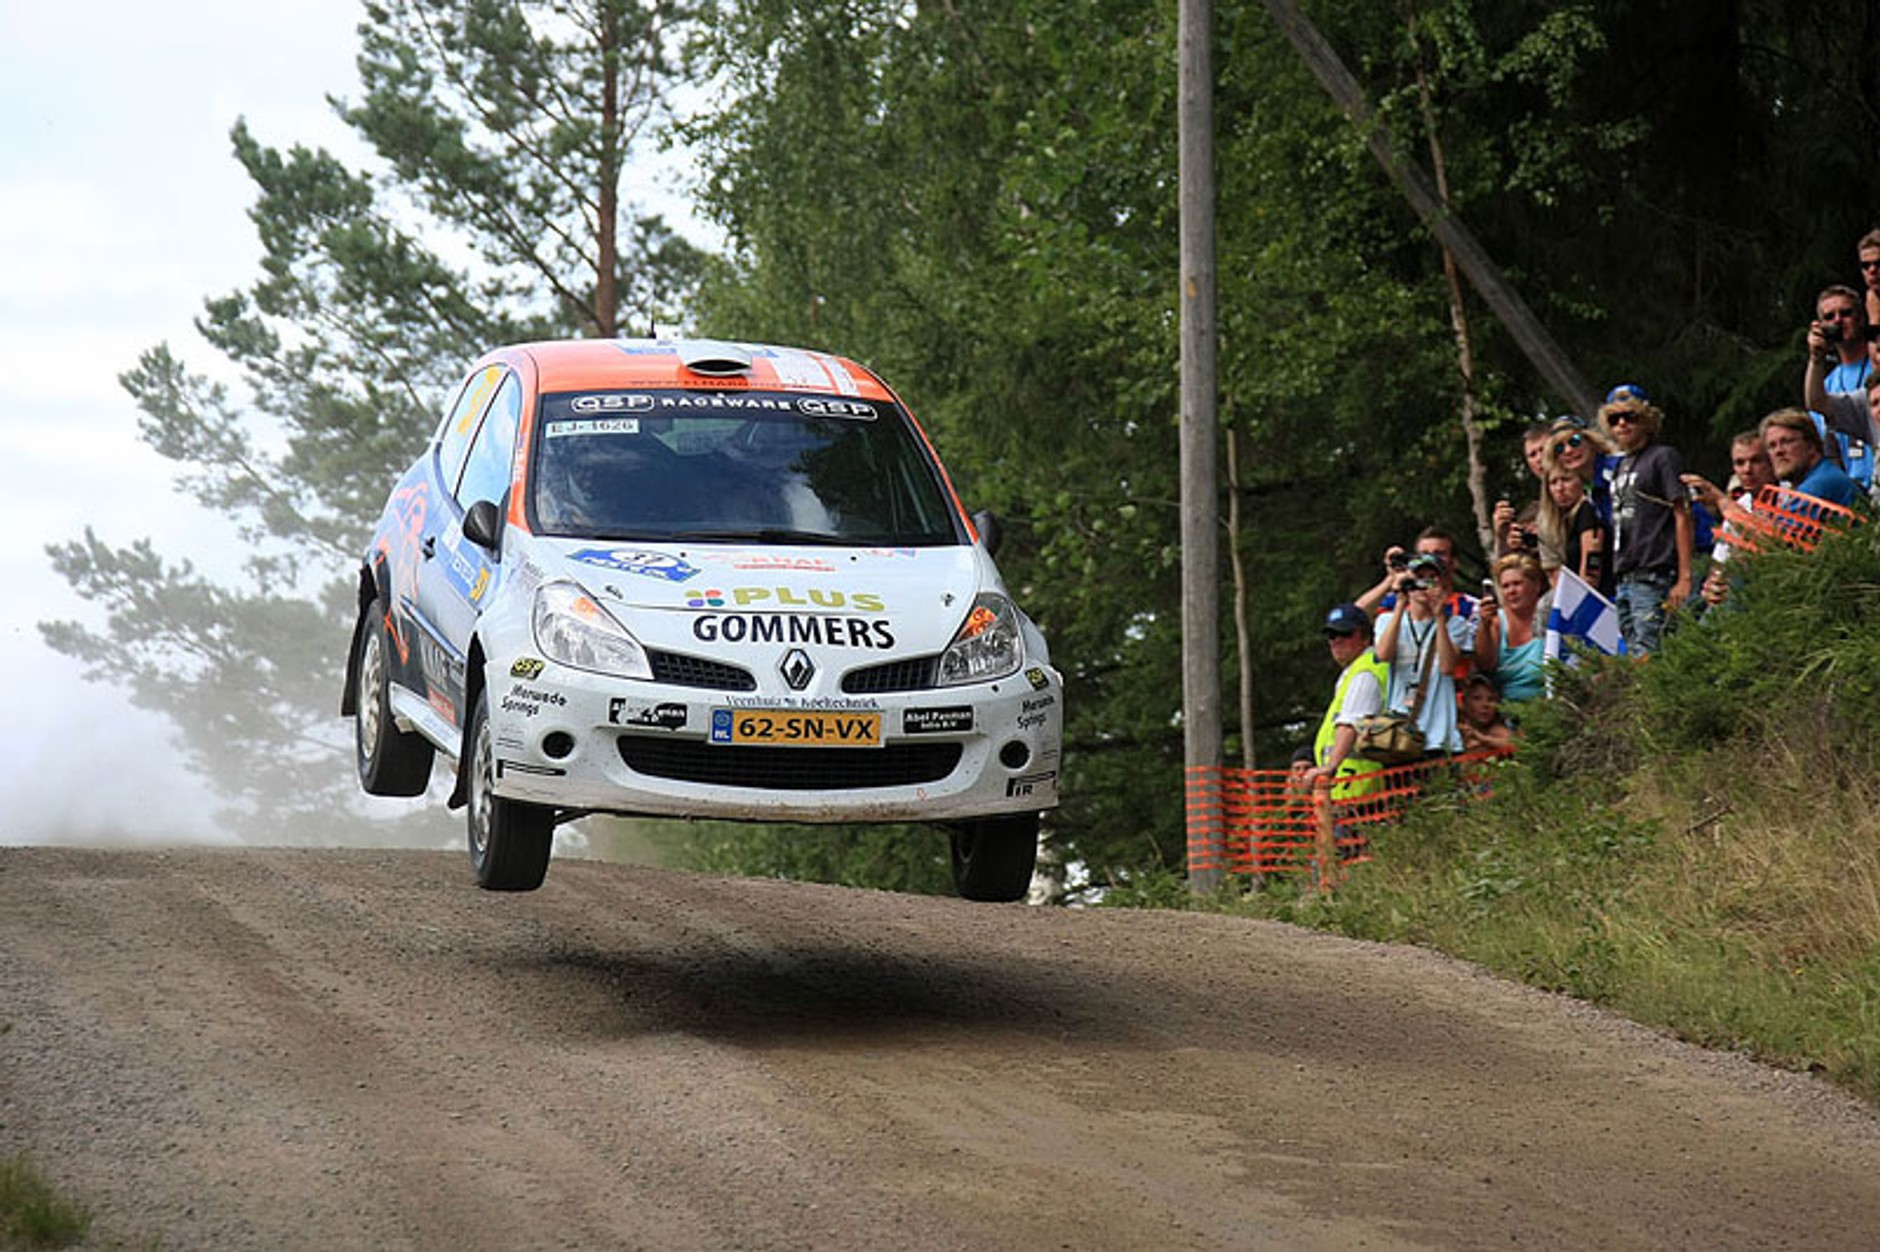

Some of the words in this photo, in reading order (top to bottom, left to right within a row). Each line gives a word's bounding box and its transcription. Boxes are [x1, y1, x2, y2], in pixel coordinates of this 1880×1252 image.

[575, 394, 649, 411] QSP
[661, 396, 792, 410] RACEWARE
[803, 399, 873, 417] QSP
[733, 587, 885, 611] PLUS
[693, 615, 895, 649] GOMMERS
[739, 718, 873, 739] 62-SN-VX
